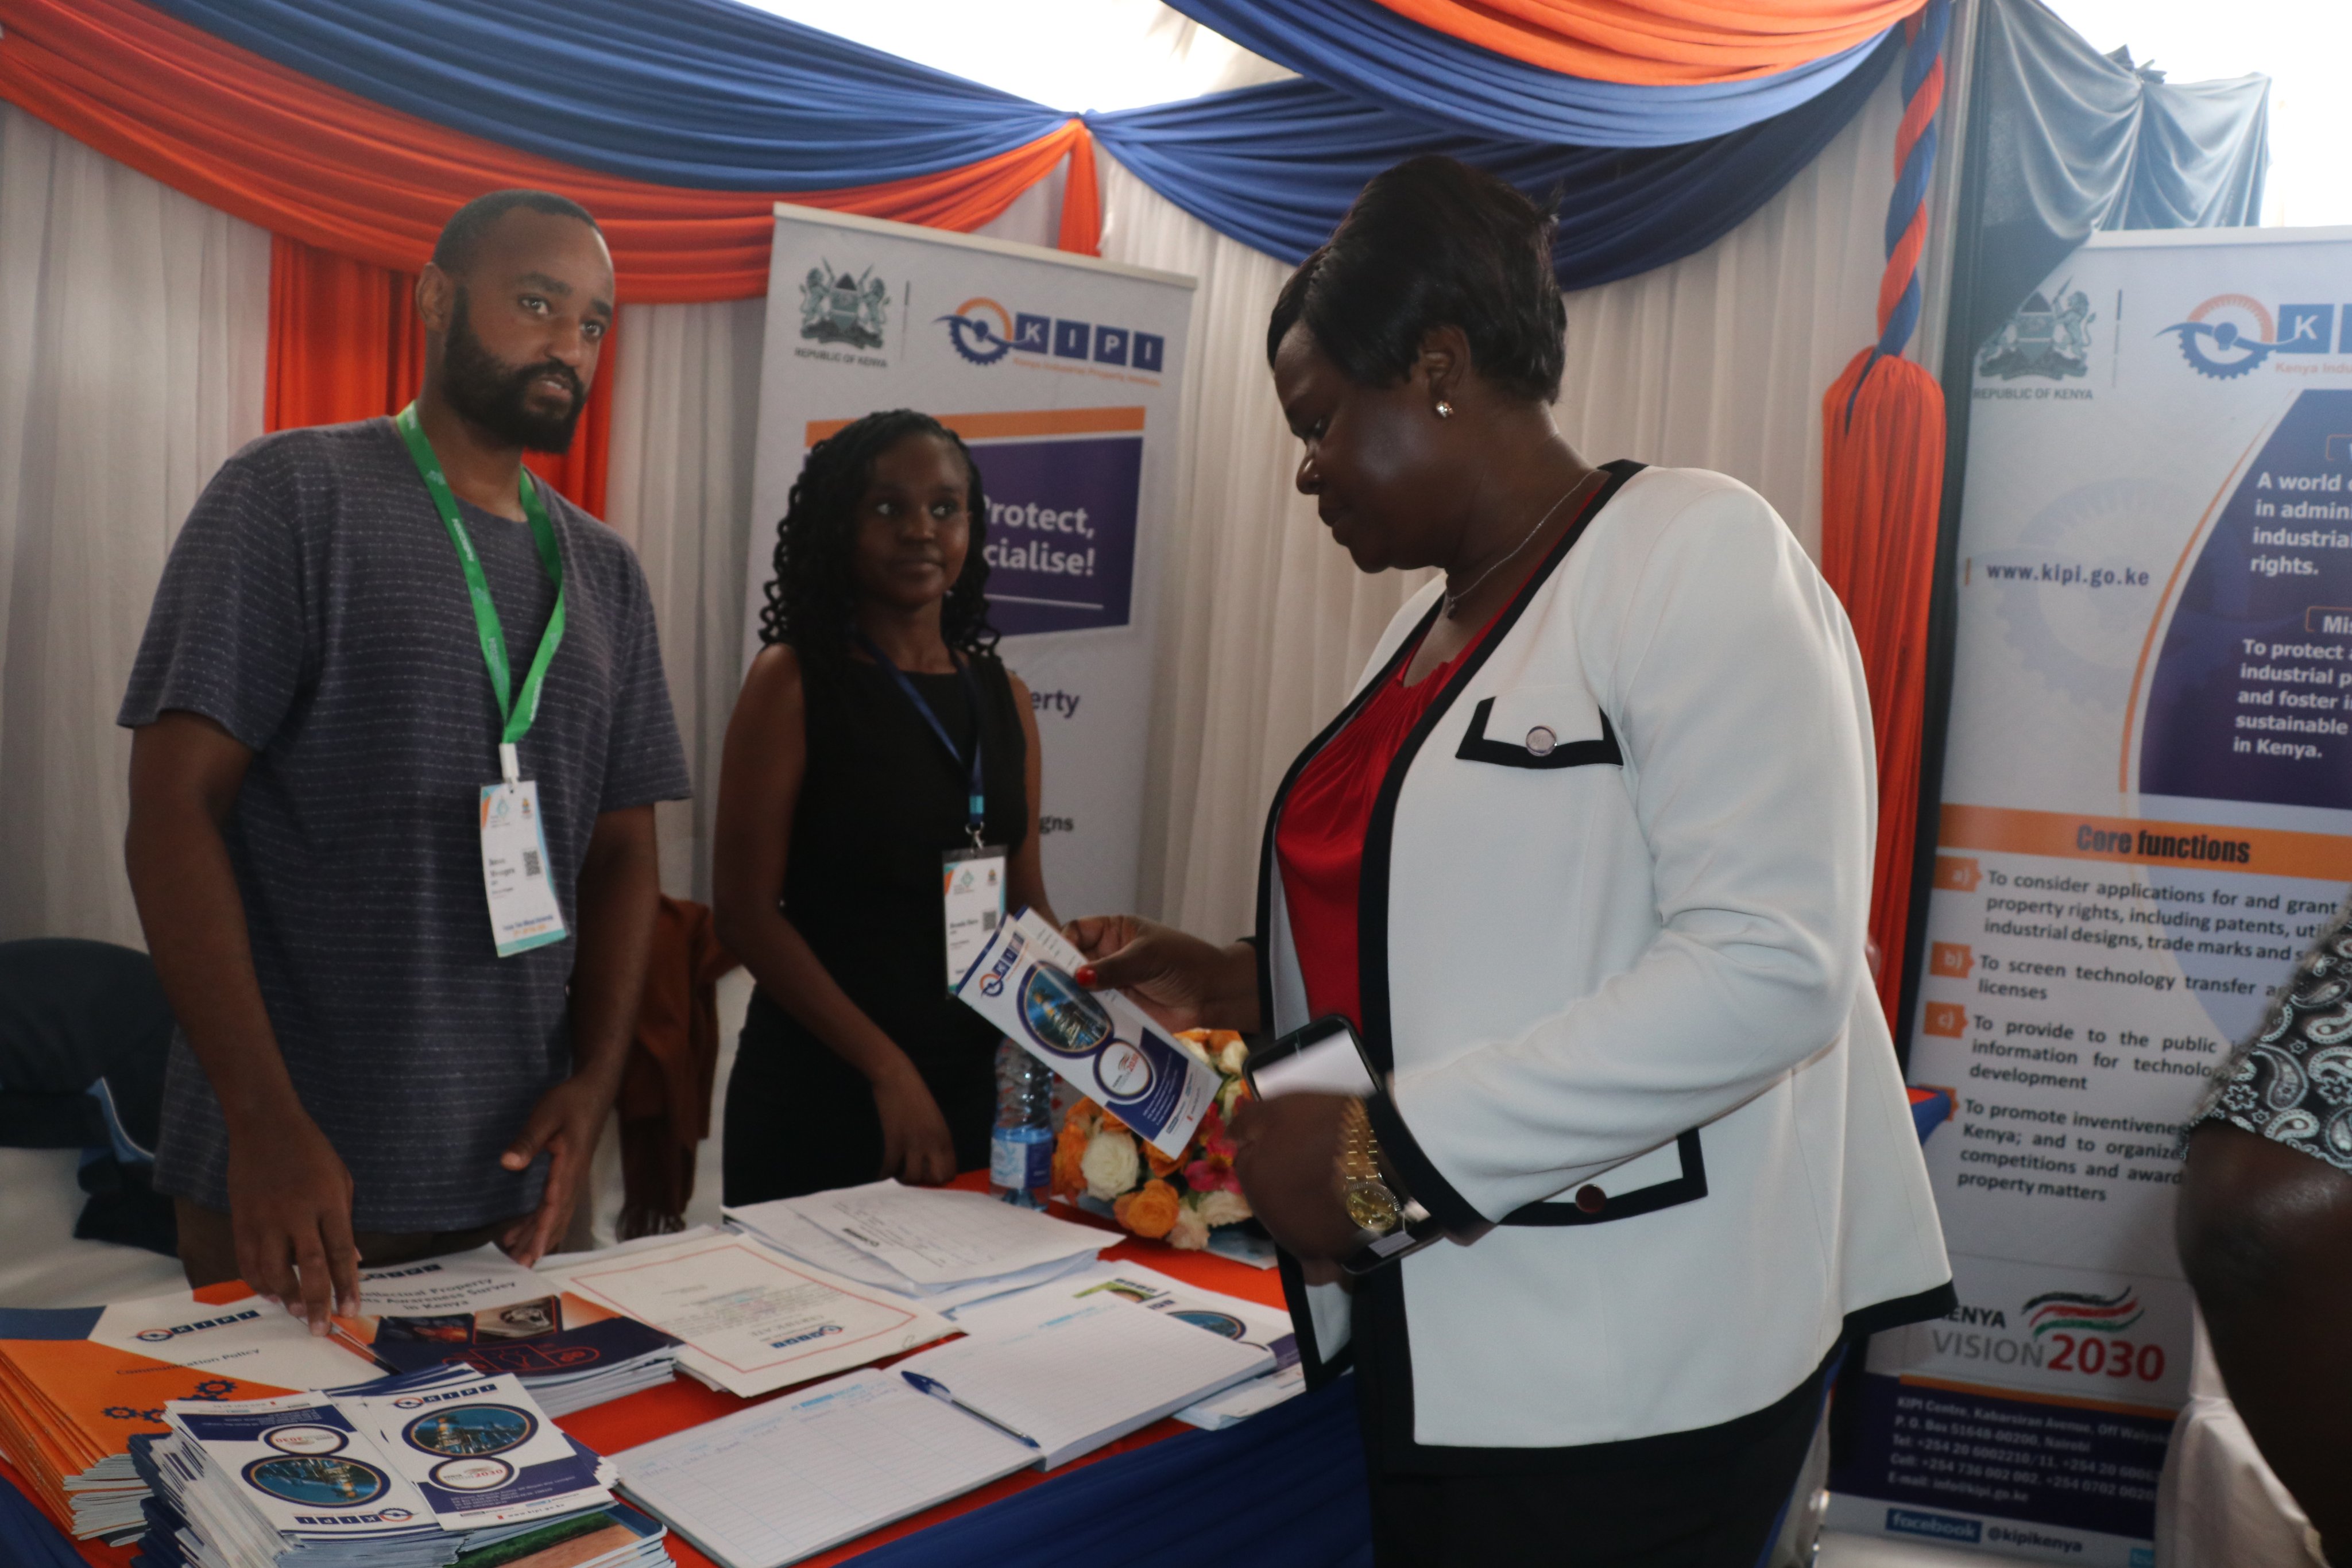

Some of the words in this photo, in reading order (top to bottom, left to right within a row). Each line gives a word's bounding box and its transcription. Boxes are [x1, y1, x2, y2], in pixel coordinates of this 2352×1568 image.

[1022, 319, 1155, 364] KIPI
[2276, 362, 2318, 375] Kenya
[1972, 388, 2032, 401] REPUBLIC
[2034, 388, 2052, 400] OF
[2054, 388, 2094, 401] KENYA
[2257, 473, 2272, 490] A
[2278, 473, 2342, 492] world
[2256, 499, 2275, 517] in
[1987, 563, 2150, 588] www.kipi.go.ke
[2250, 555, 2319, 577] rights.
[2242, 638, 2267, 656] To
[2271, 643, 2345, 660] protect
[2240, 663, 2334, 684] industrial
[2237, 688, 2274, 706] and
[2278, 690, 2339, 709] foster
[2235, 715, 2349, 735] sustainable
[2233, 736, 2252, 752] in
[2257, 738, 2323, 761] Kenya.
[2076, 824, 2132, 854] Core
[2137, 829, 2252, 865] functions
[1989, 870, 2008, 886] To
[2014, 875, 2090, 893] consider
[2096, 881, 2206, 904] applications
[2212, 889, 2238, 905] for
[2245, 894, 2280, 909] and
[2286, 899, 2339, 915] grant
[1986, 896, 2065, 918] property
[2068, 902, 2125, 924] rights,
[2130, 907, 2211, 932] including
[2215, 917, 2290, 938] patents,
[1984, 917, 2068, 940] industrial
[2071, 926, 2143, 951] designs,
[2148, 935, 2195, 953] trade
[2197, 940, 2253, 957] marks
[2256, 945, 2292, 961] and
[1980, 954, 2000, 971] To
[2009, 960, 2066, 978] screen
[2075, 965, 2176, 991] technology
[2185, 975, 2257, 994] transfer
[1978, 977, 2048, 1000] licenses
[1974, 1014, 1994, 1031] To
[2006, 1021, 2075, 1039] provide
[2087, 1028, 2107, 1044] to
[2119, 1031, 2149, 1048] the
[2162, 1035, 2218, 1054] public
[1972, 1037, 2078, 1064] information
[2093, 1052, 2119, 1069] for
[1970, 1063, 2088, 1091] development
[1964, 1098, 1984, 1115] To
[1990, 1105, 2067, 1125] promote
[1963, 1123, 2022, 1147] Kenya;
[2032, 1131, 2066, 1149] and
[2076, 1136, 2096, 1152] to
[1959, 1148, 2077, 1175] competitions
[2085, 1160, 2119, 1179] and
[1957, 1171, 2035, 1196] property
[2037, 1180, 2107, 1202] matters
[1943, 1305, 2006, 1330] ENYA
[115, 1357, 219, 1376] Communication
[222, 1348, 260, 1361] Policy
[1932, 1329, 2045, 1368] VISION
[2047, 1333, 2166, 1383] 2030
[426, 1384, 496, 1401] KIPI
[1891, 1512, 1976, 1540] facebook
[1986, 1526, 2083, 1553] @kipikenya
